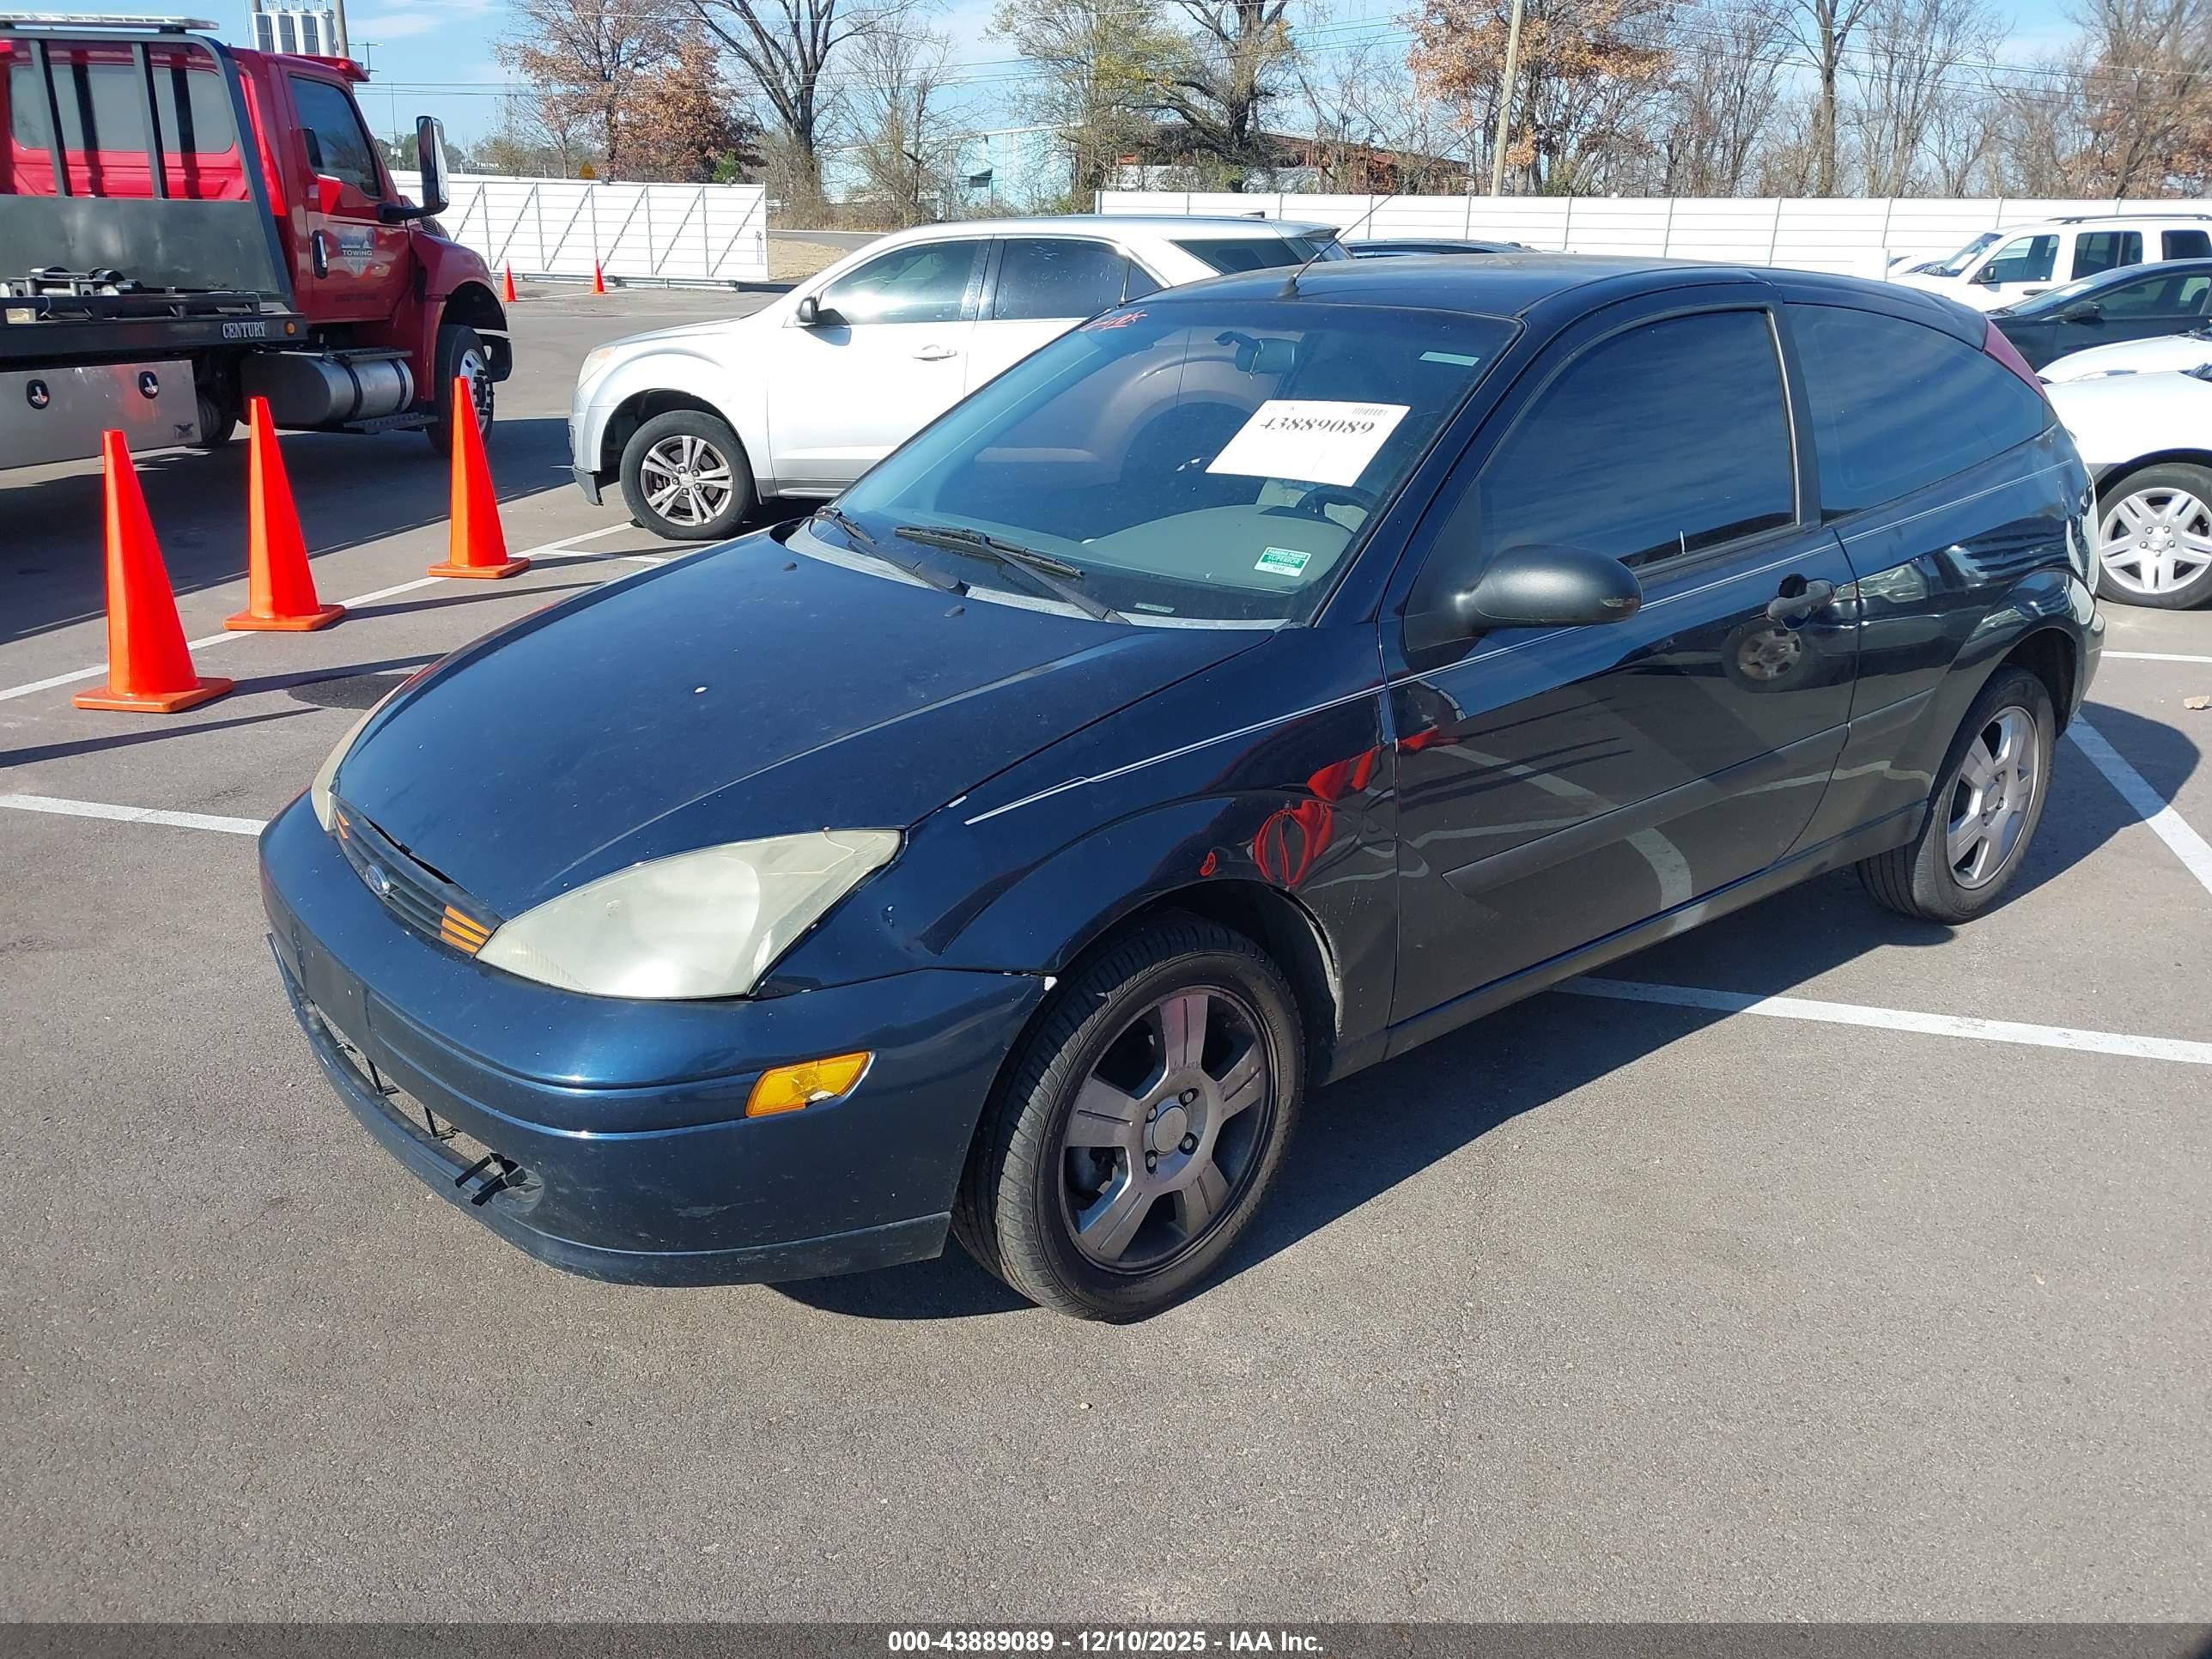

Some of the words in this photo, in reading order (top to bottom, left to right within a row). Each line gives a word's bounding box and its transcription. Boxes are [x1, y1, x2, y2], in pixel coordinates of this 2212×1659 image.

[222, 321, 266, 338] CENTURY
[1260, 417, 1376, 434] 43889089
[1267, 555, 1301, 564] SUPERIOR
